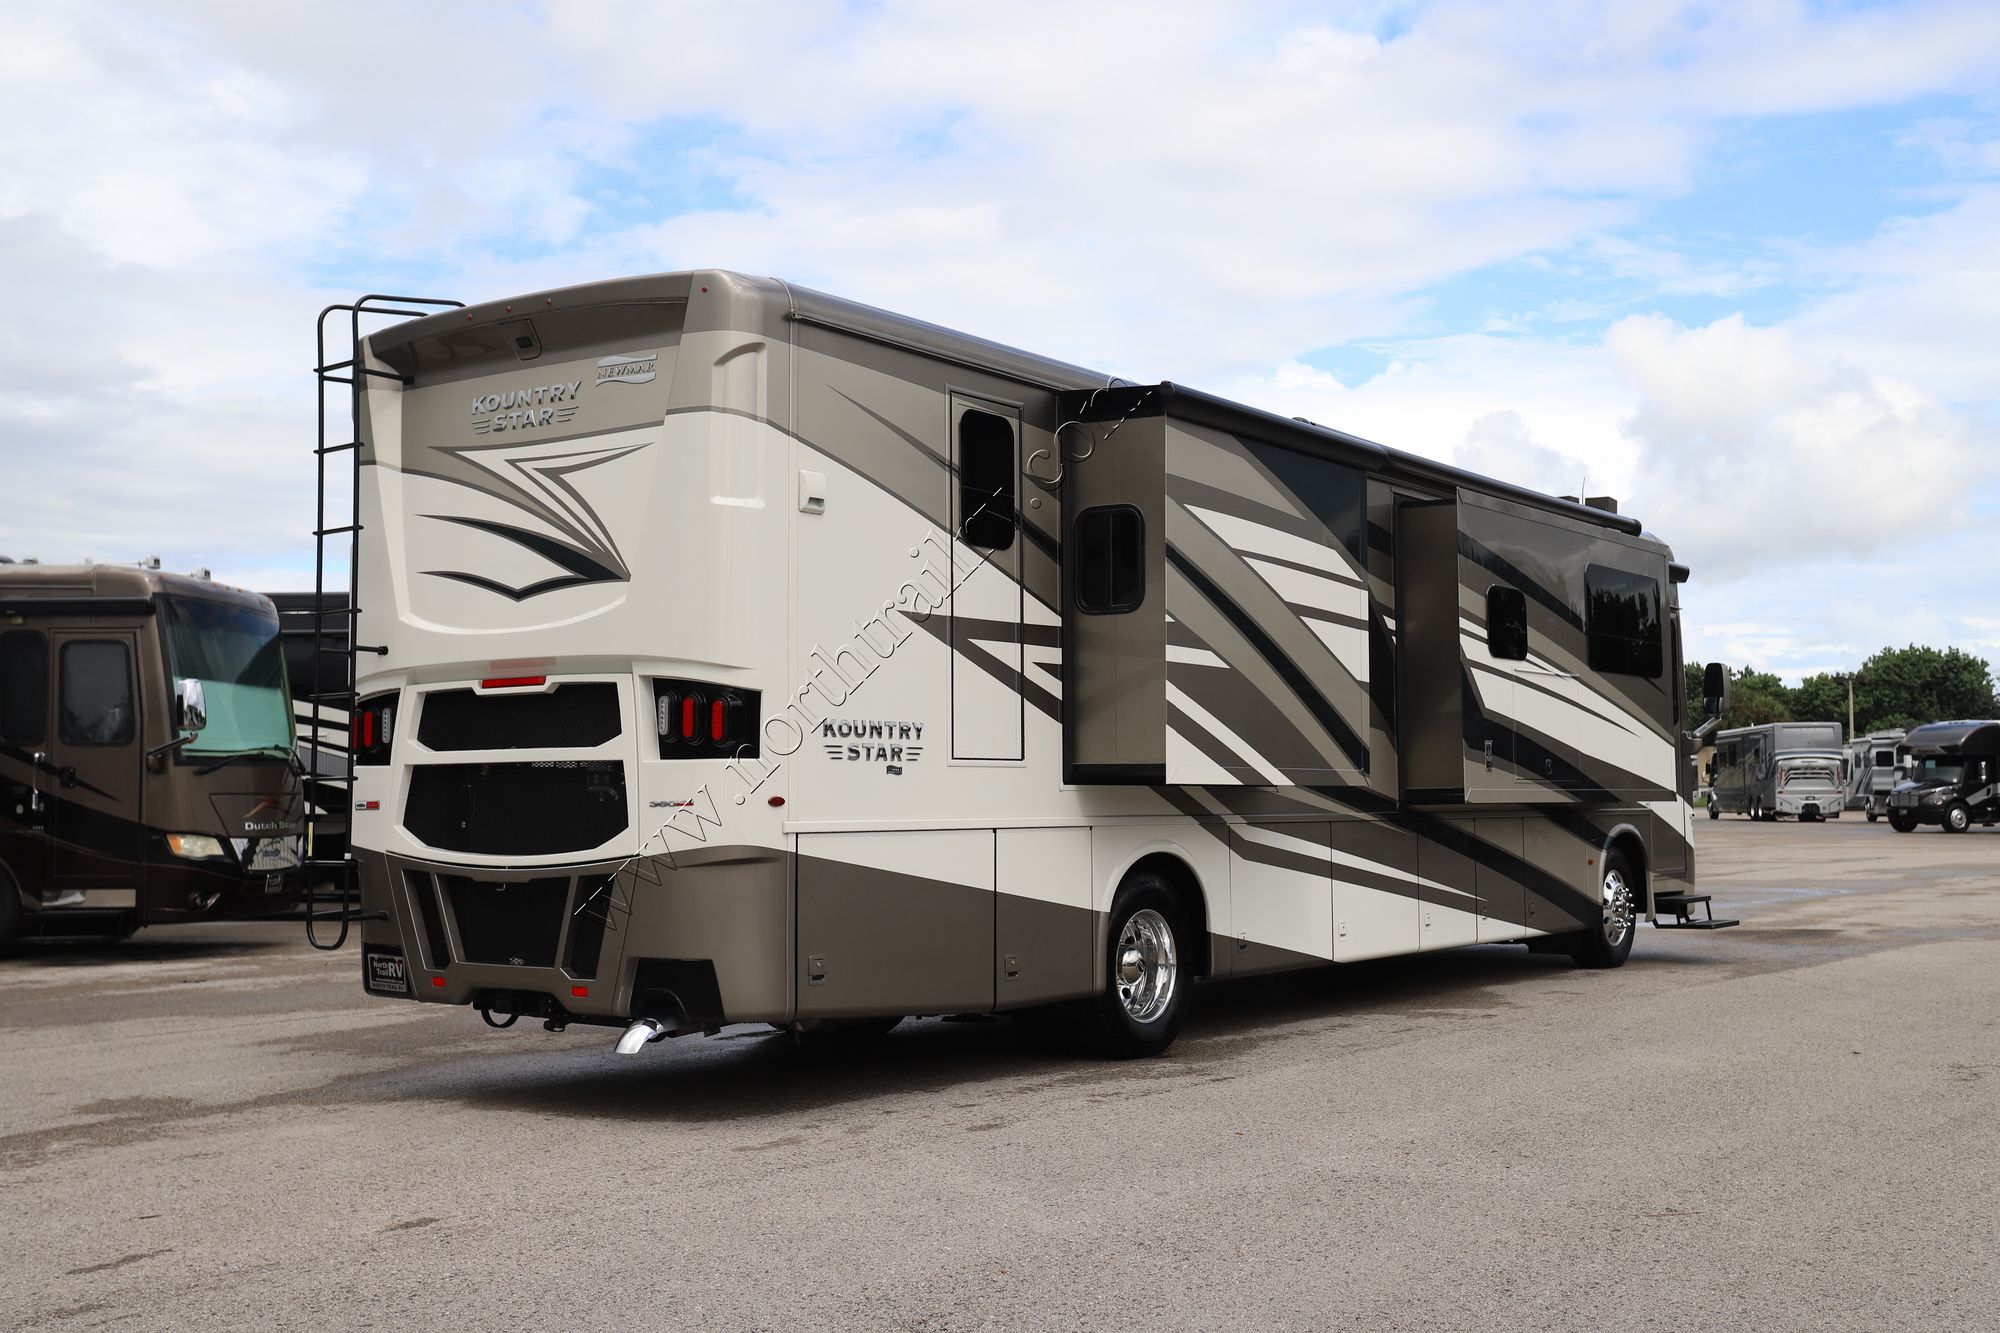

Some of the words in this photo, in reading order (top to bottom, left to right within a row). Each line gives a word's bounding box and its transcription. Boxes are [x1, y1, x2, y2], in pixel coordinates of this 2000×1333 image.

[599, 362, 656, 379] NEWMAR
[471, 379, 582, 415] KOUNTRY
[493, 407, 554, 432] STAR
[822, 719, 924, 740] KOUNTRY
[847, 743, 903, 762] STAR
[244, 821, 278, 831] Dutch
[279, 820, 297, 829] Star
[388, 962, 403, 978] RV
